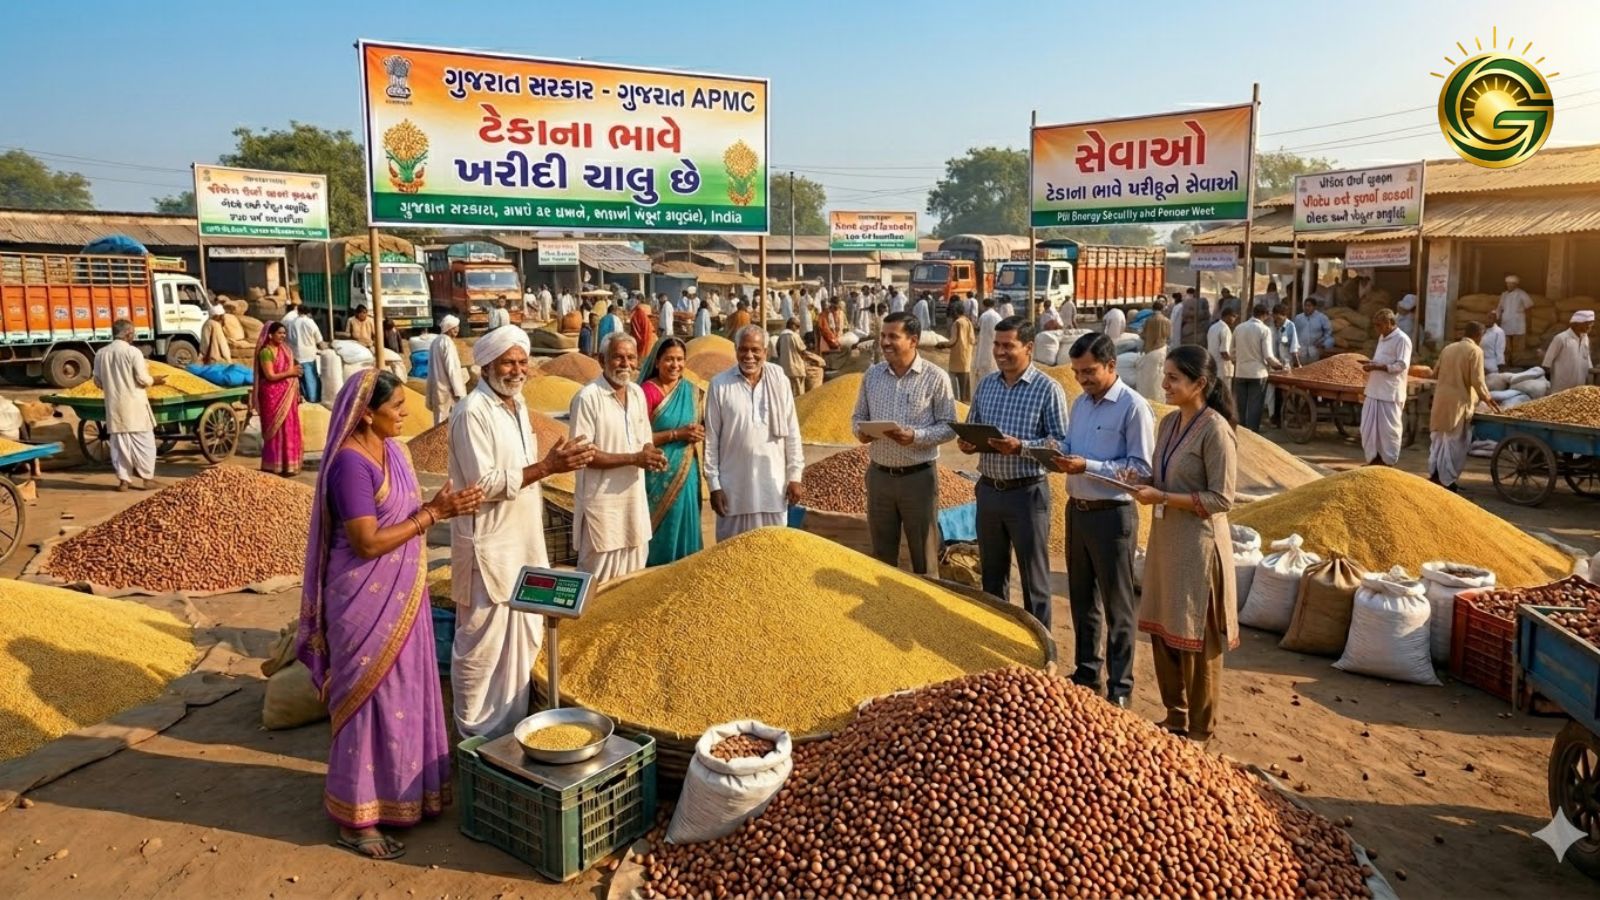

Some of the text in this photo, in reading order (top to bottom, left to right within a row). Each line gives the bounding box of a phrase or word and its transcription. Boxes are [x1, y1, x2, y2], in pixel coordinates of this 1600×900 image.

[445, 69, 520, 98] ગુજરાત
[528, 76, 594, 100] સરકાર
[617, 84, 685, 111] ગુજરાત
[691, 87, 755, 113] APMC
[479, 103, 681, 153] ટેકાના ભાવે
[1075, 120, 1206, 172] સેવાઓ
[454, 150, 700, 206] ખરીદી ચાલુ છે
[1092, 179, 1122, 199] ભાવે
[1186, 170, 1239, 194] સેવાઓ
[711, 210, 743, 224] India
